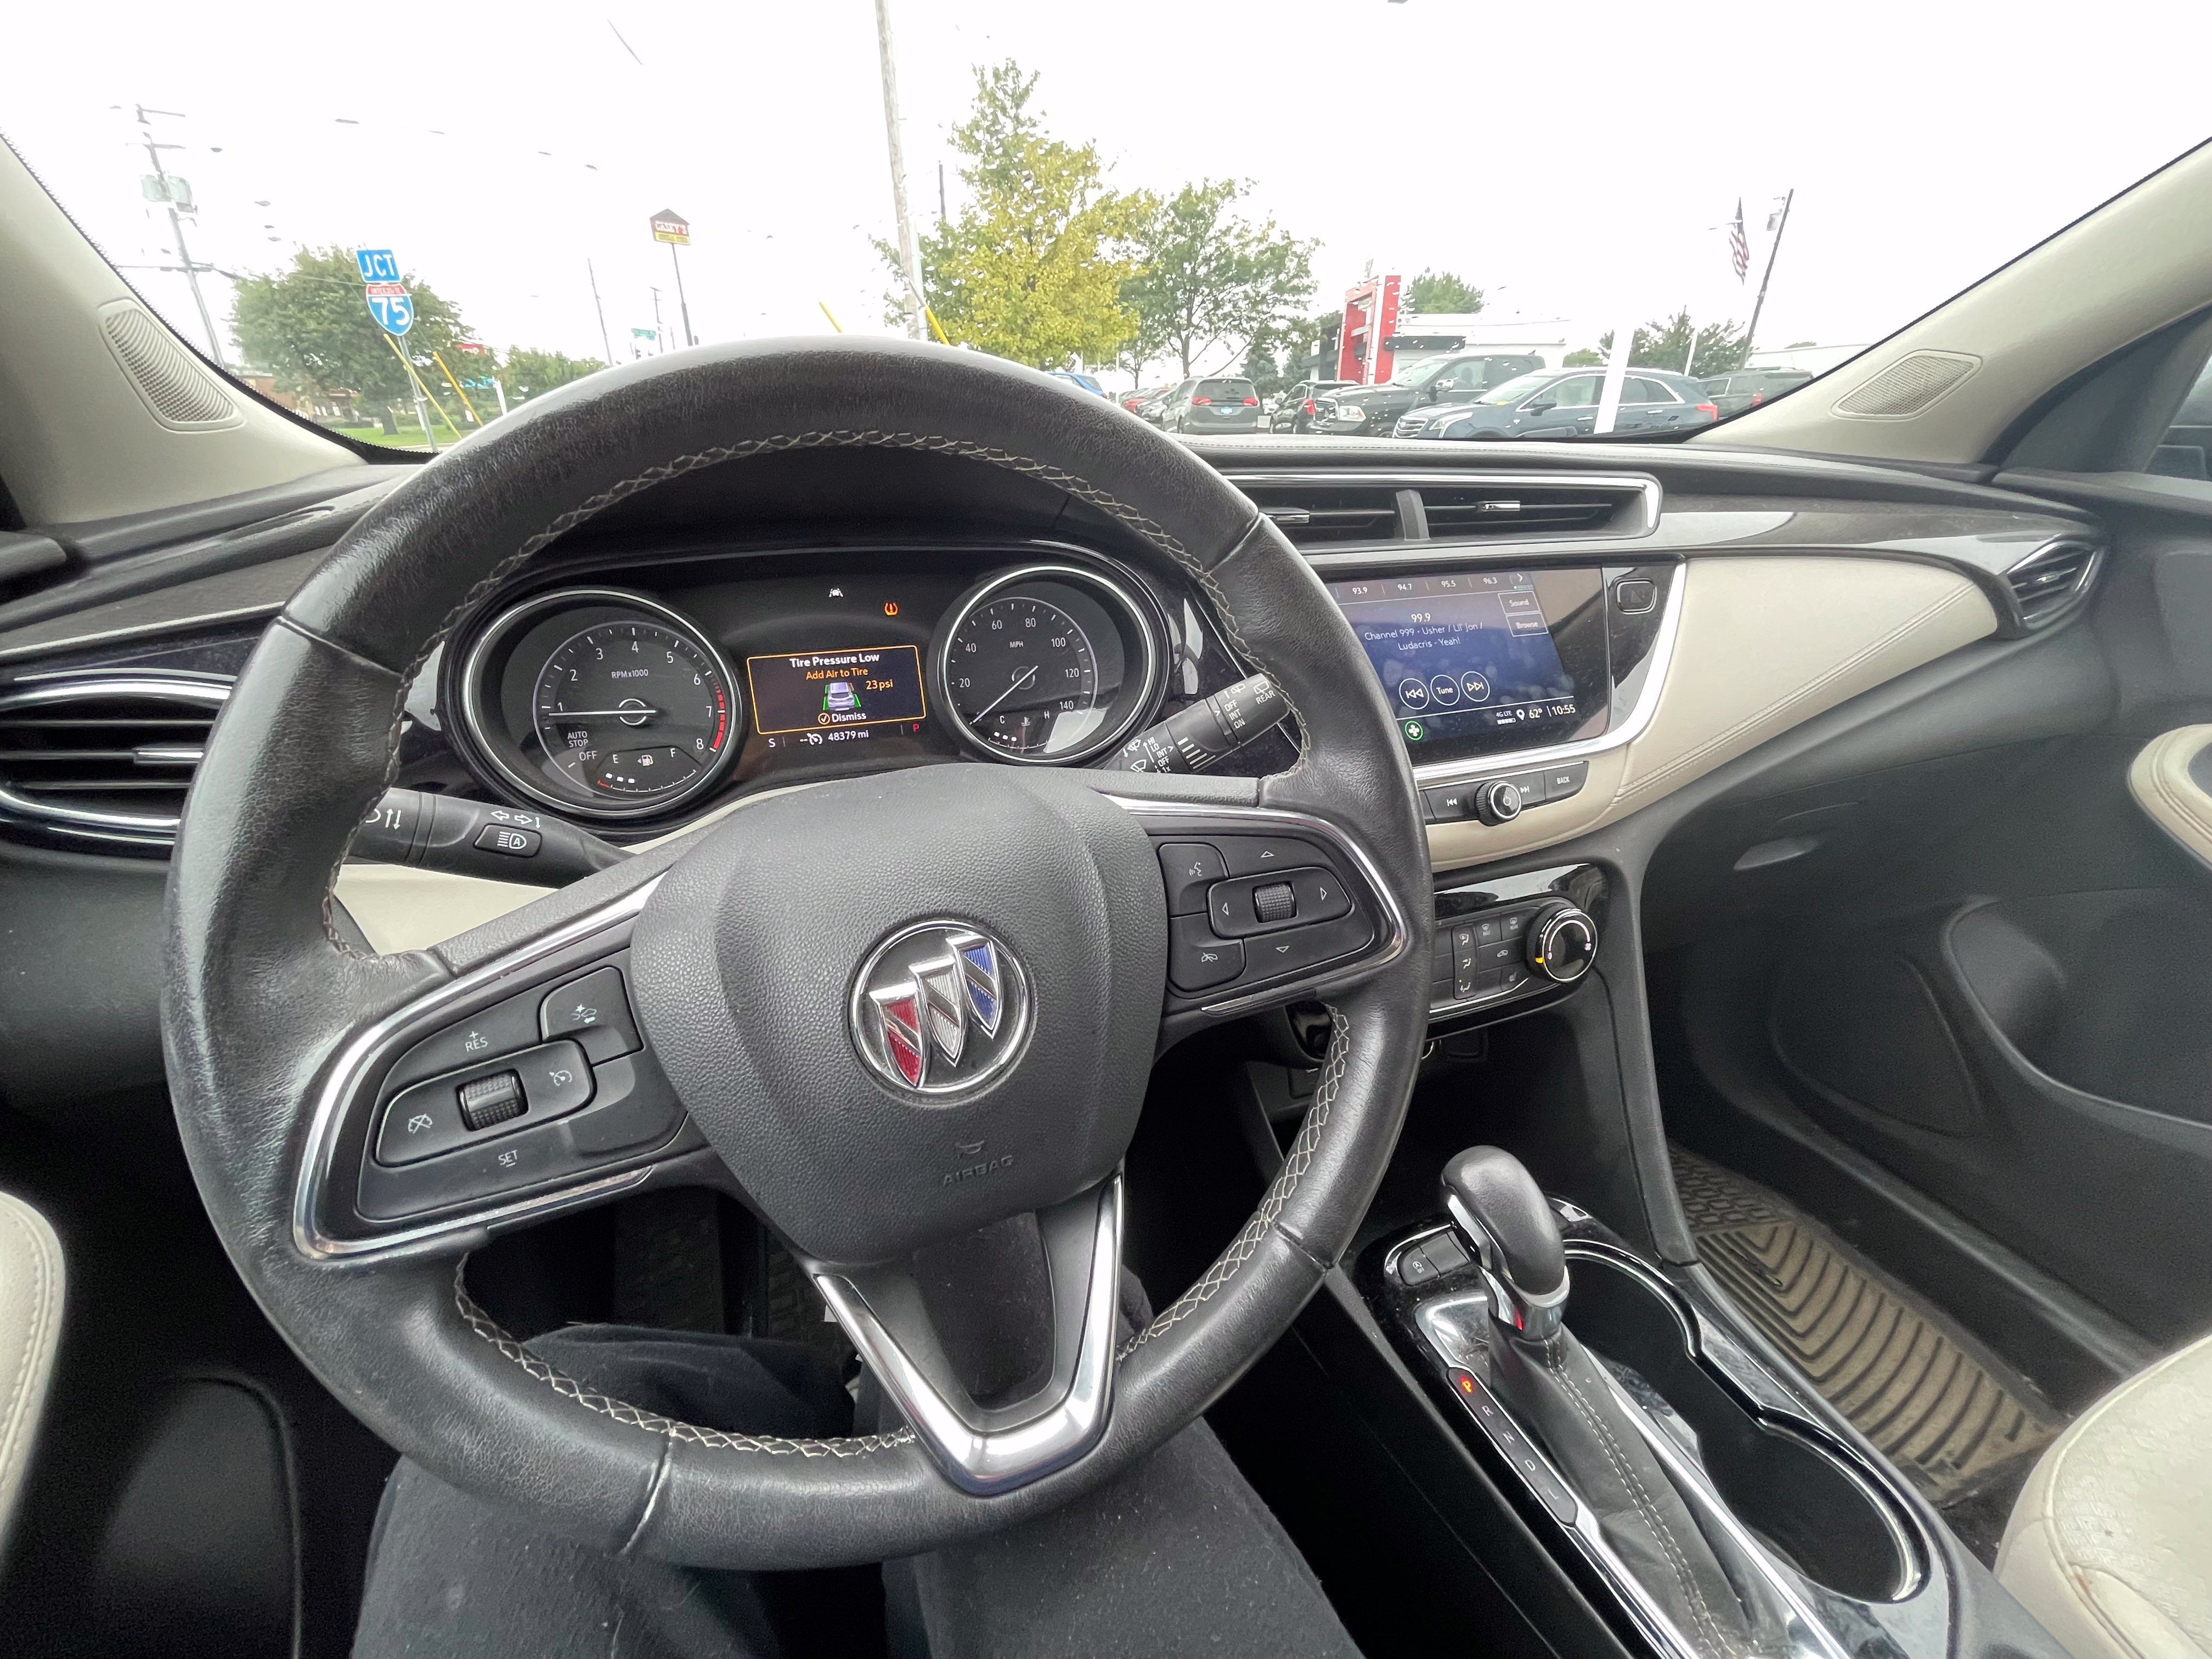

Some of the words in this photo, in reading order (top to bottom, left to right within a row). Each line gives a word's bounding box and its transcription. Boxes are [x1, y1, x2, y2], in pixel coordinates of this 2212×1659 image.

[364, 254, 395, 277] JCT
[371, 297, 410, 326] 75
[1352, 586, 1368, 595] 93.9
[1025, 618, 1036, 628] 80
[1411, 613, 1431, 623] 99.9
[991, 620, 1002, 630] 60
[1364, 629, 1398, 640] Channel
[1399, 628, 1415, 636] 999
[1421, 626, 1445, 635] Usher
[1465, 623, 1478, 633] Jon
[631, 641, 639, 653] 4
[966, 643, 977, 653] 40
[1051, 637, 1066, 647] 100
[1398, 640, 1432, 651] Ludacris
[1438, 636, 1461, 647] Yeah!
[596, 648, 603, 660] 3
[667, 651, 674, 663] 5
[789, 657, 810, 668] Tire
[812, 655, 857, 667] Pressure
[859, 653, 880, 663] Low
[569, 669, 578, 681] 2
[611, 669, 649, 679] RPMx1000
[693, 673, 701, 685] 6
[806, 670, 824, 680] Add
[826, 669, 838, 679] Air
[840, 669, 850, 678] to
[851, 668, 868, 676] Tire
[1065, 668, 1080, 678] 120
[865, 680, 878, 690] 23
[879, 679, 893, 691] psi
[960, 678, 970, 688] 20
[1436, 686, 1453, 695] Tune
[1256, 690, 1276, 705] REAR
[557, 702, 563, 712] 1
[1059, 700, 1074, 710] 140
[1224, 699, 1237, 712] OFF
[1552, 704, 1576, 716] 10:55
[706, 706, 712, 718] 7
[832, 712, 867, 723] Dismiss
[1044, 711, 1049, 719] H
[1228, 708, 1241, 721] INT
[1000, 715, 1005, 724] C
[1234, 718, 1246, 729] ON
[912, 724, 919, 732] P
[567, 731, 588, 740] AUTO
[828, 731, 856, 742] 48379
[857, 730, 869, 738] mi
[1147, 736, 1155, 746] HI
[568, 739, 588, 748] STOP
[696, 738, 704, 750] 8
[1150, 743, 1160, 752] LO
[579, 751, 597, 761] OFF
[670, 748, 676, 758] F
[1156, 747, 1167, 758] INT
[612, 754, 619, 764] E
[1158, 755, 1169, 767] OFF
[1556, 776, 1570, 785] BACK
[465, 1037, 488, 1052] RES
[498, 1149, 518, 1166] SET
[943, 1154, 1014, 1188] AIRBAG
[1461, 1379, 1471, 1393] P
[1482, 1405, 1494, 1417] R
[1503, 1431, 1515, 1444] N
[1525, 1459, 1536, 1471] D
[1548, 1488, 1559, 1500] L
